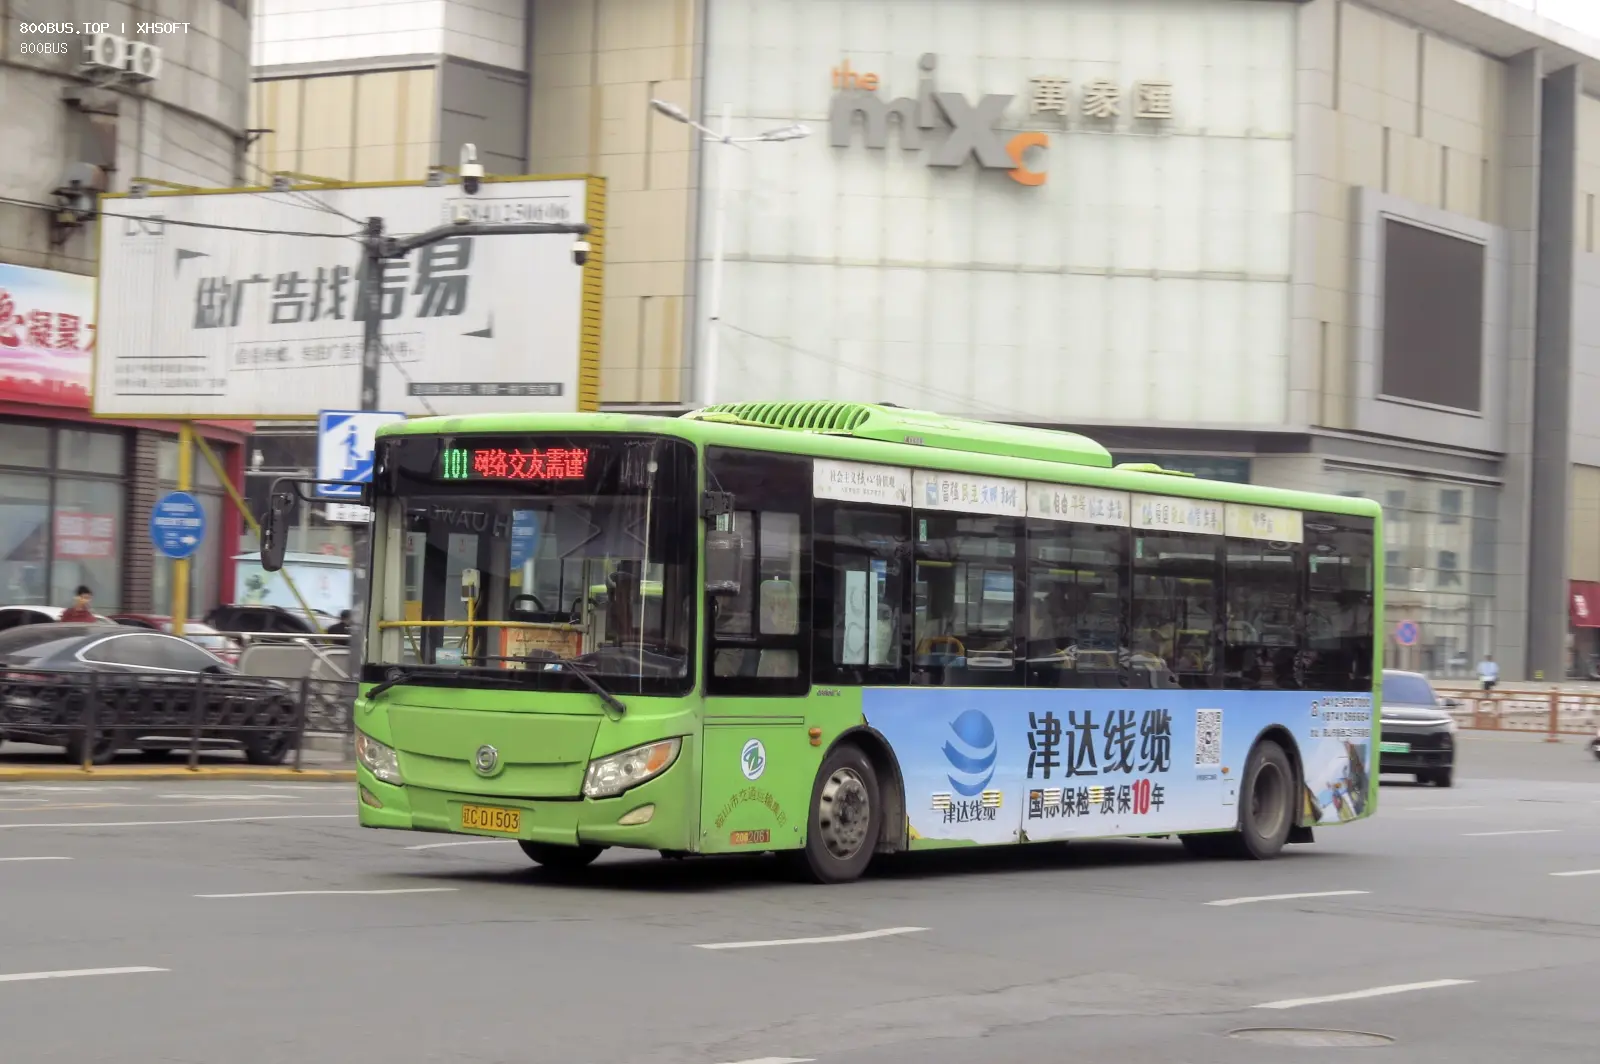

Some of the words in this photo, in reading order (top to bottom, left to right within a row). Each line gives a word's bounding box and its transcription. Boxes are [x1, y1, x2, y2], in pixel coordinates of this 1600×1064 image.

[831, 59, 879, 91] the
[443, 449, 468, 479] 101
[474, 448, 589, 479] 网络交友需谨
[1027, 708, 1172, 779] 津达线缆
